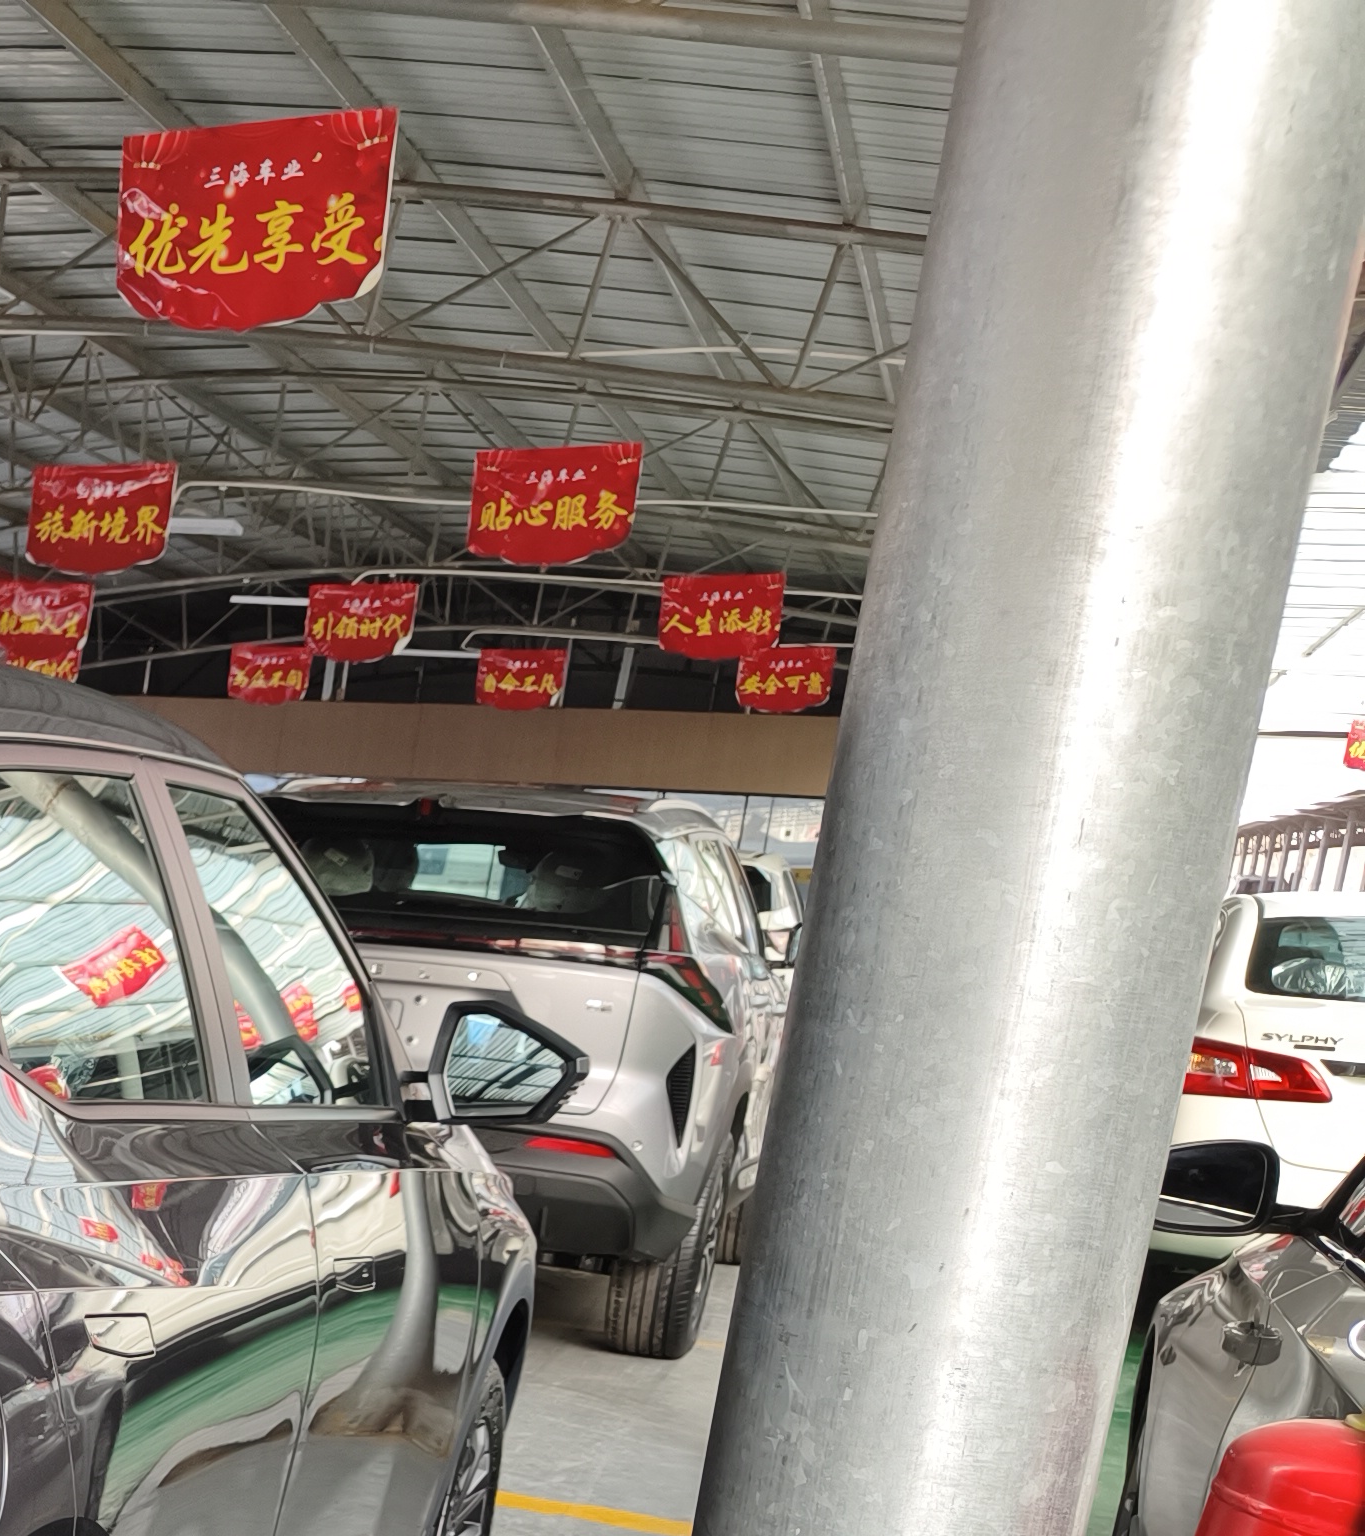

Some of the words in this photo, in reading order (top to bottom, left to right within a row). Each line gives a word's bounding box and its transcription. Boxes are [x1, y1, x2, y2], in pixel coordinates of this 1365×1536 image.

[203, 159, 305, 189] 三海车业
[129, 191, 369, 277] 优先享受
[476, 489, 629, 532] 贴心服务
[311, 611, 408, 641] 引领时代
[661, 605, 773, 636] 人生添彩
[1261, 1033, 1344, 1046] SYLPHY
